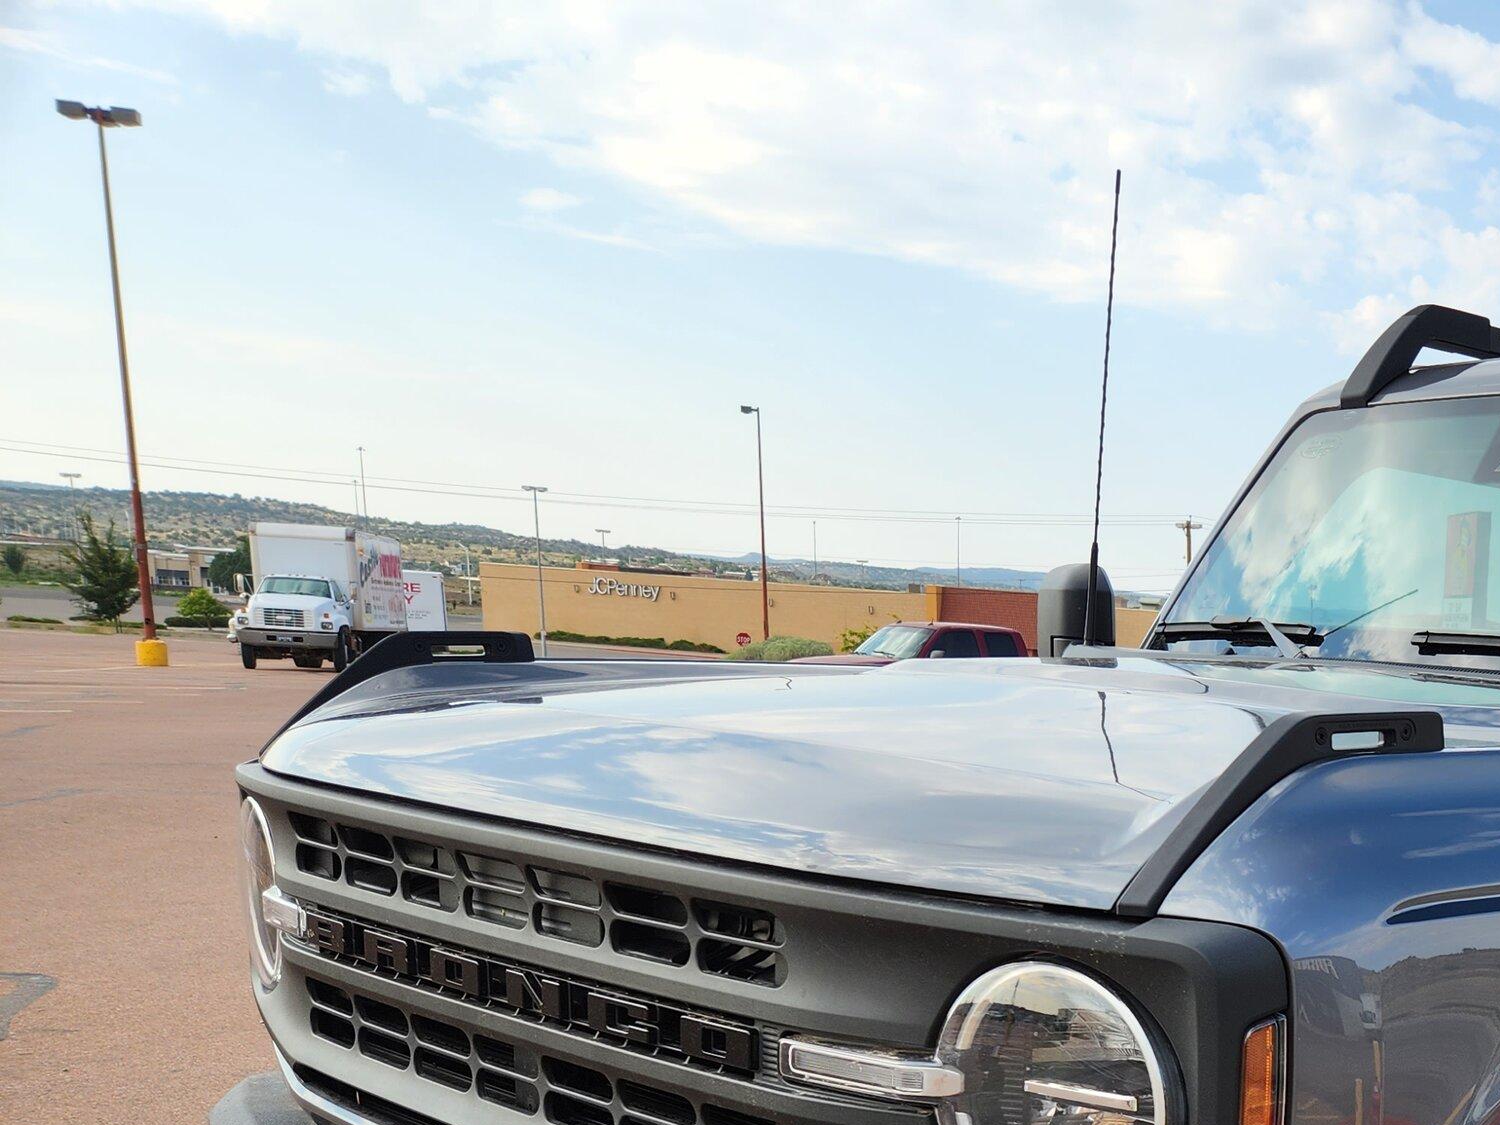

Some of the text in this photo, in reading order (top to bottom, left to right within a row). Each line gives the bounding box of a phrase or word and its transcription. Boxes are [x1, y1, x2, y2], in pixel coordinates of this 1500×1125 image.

[588, 577, 661, 602] JCPenney
[736, 635, 751, 644] STOP
[304, 908, 759, 1071] BRONCO
